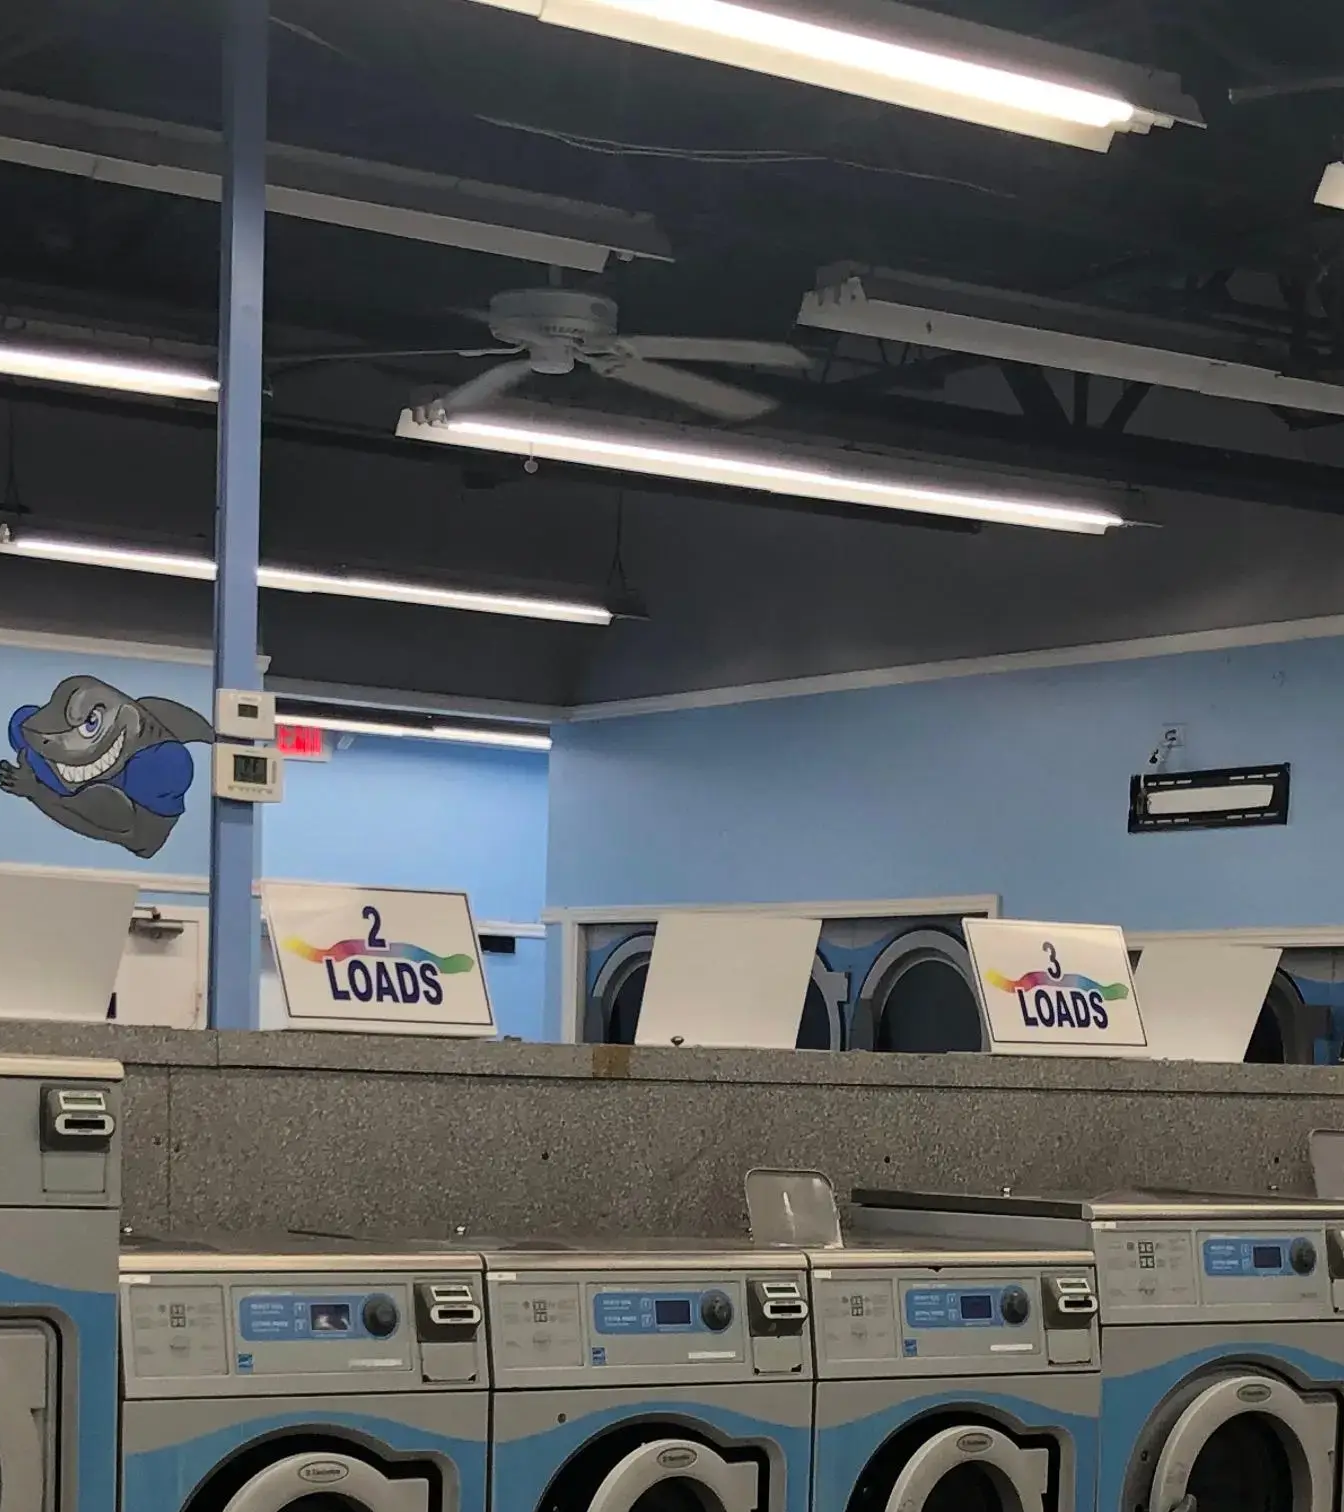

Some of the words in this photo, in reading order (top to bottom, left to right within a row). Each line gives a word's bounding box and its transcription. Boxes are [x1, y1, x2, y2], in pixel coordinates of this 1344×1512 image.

[362, 905, 386, 948] 2
[1042, 941, 1061, 979] 3
[325, 959, 444, 1005] LOADS
[1017, 989, 1109, 1029] LOADS
